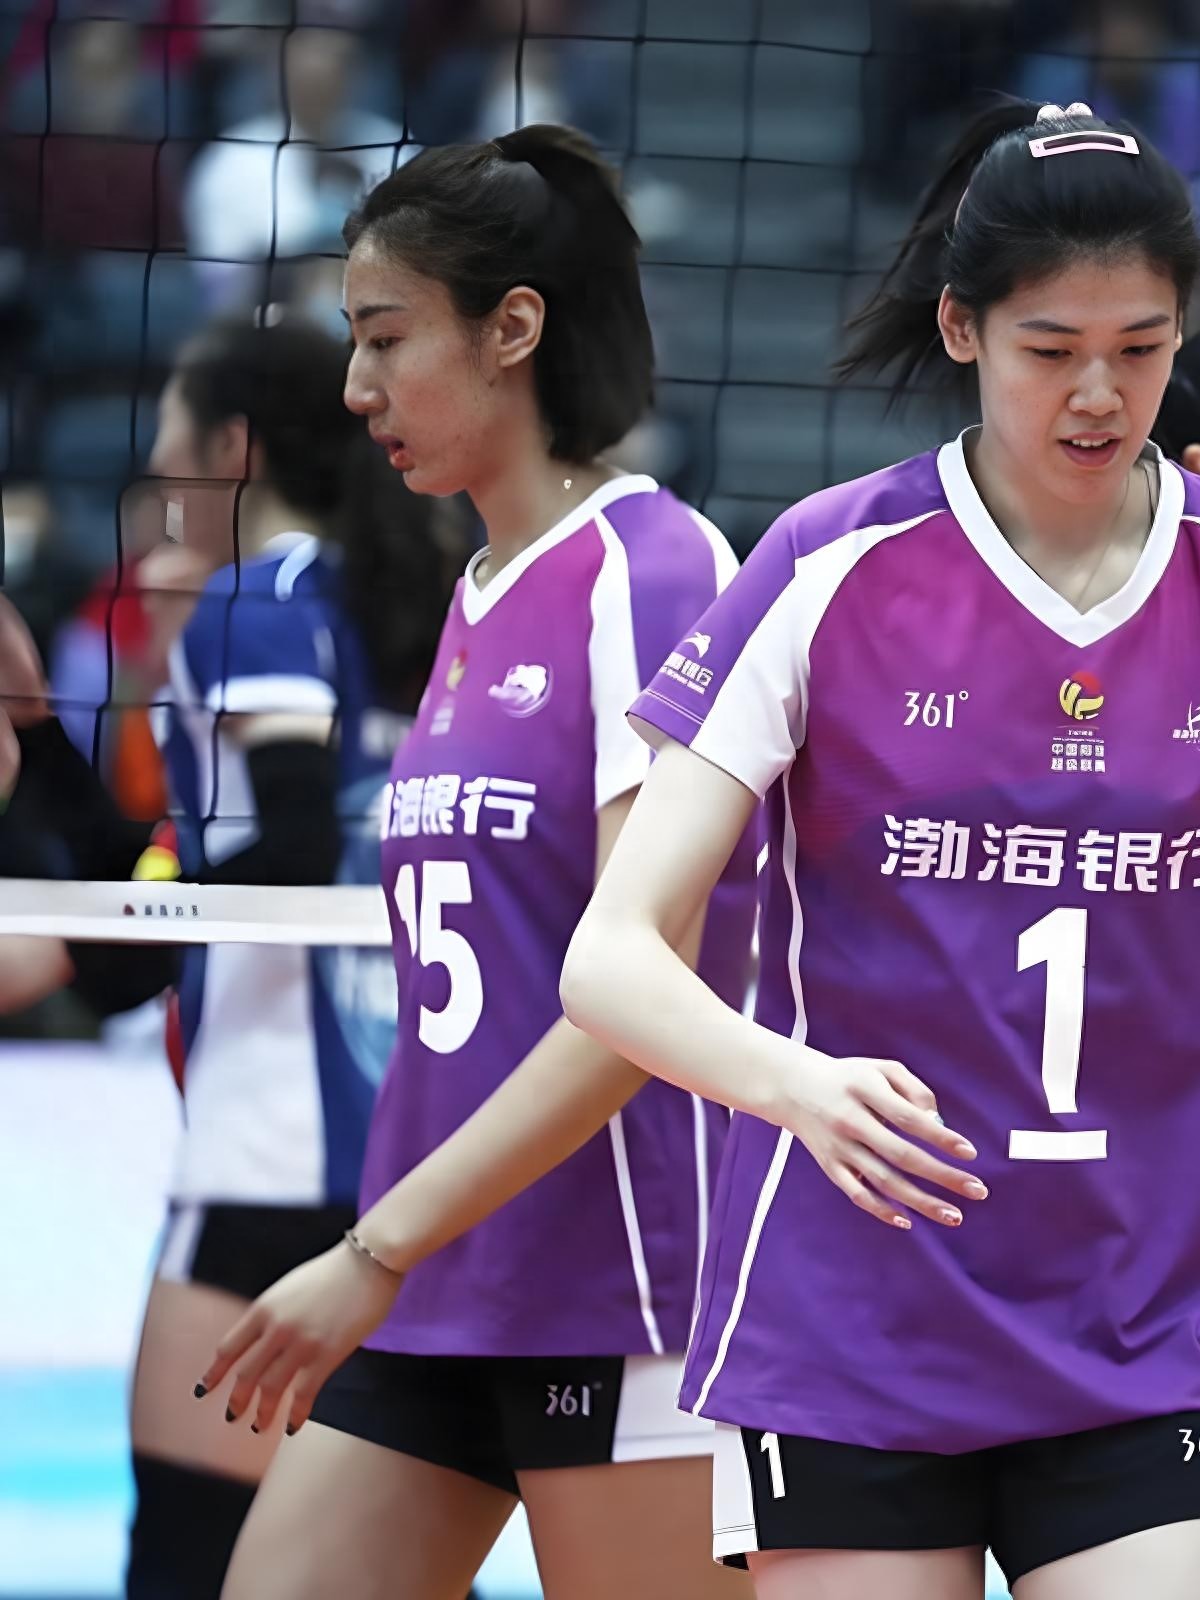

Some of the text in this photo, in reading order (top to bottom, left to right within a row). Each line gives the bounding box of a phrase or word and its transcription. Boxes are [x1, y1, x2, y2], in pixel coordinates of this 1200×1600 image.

[379, 773, 537, 841] 海银行
[393, 860, 484, 1055] 15
[1016, 906, 1089, 1114] 1
[760, 1431, 786, 1499] 1
